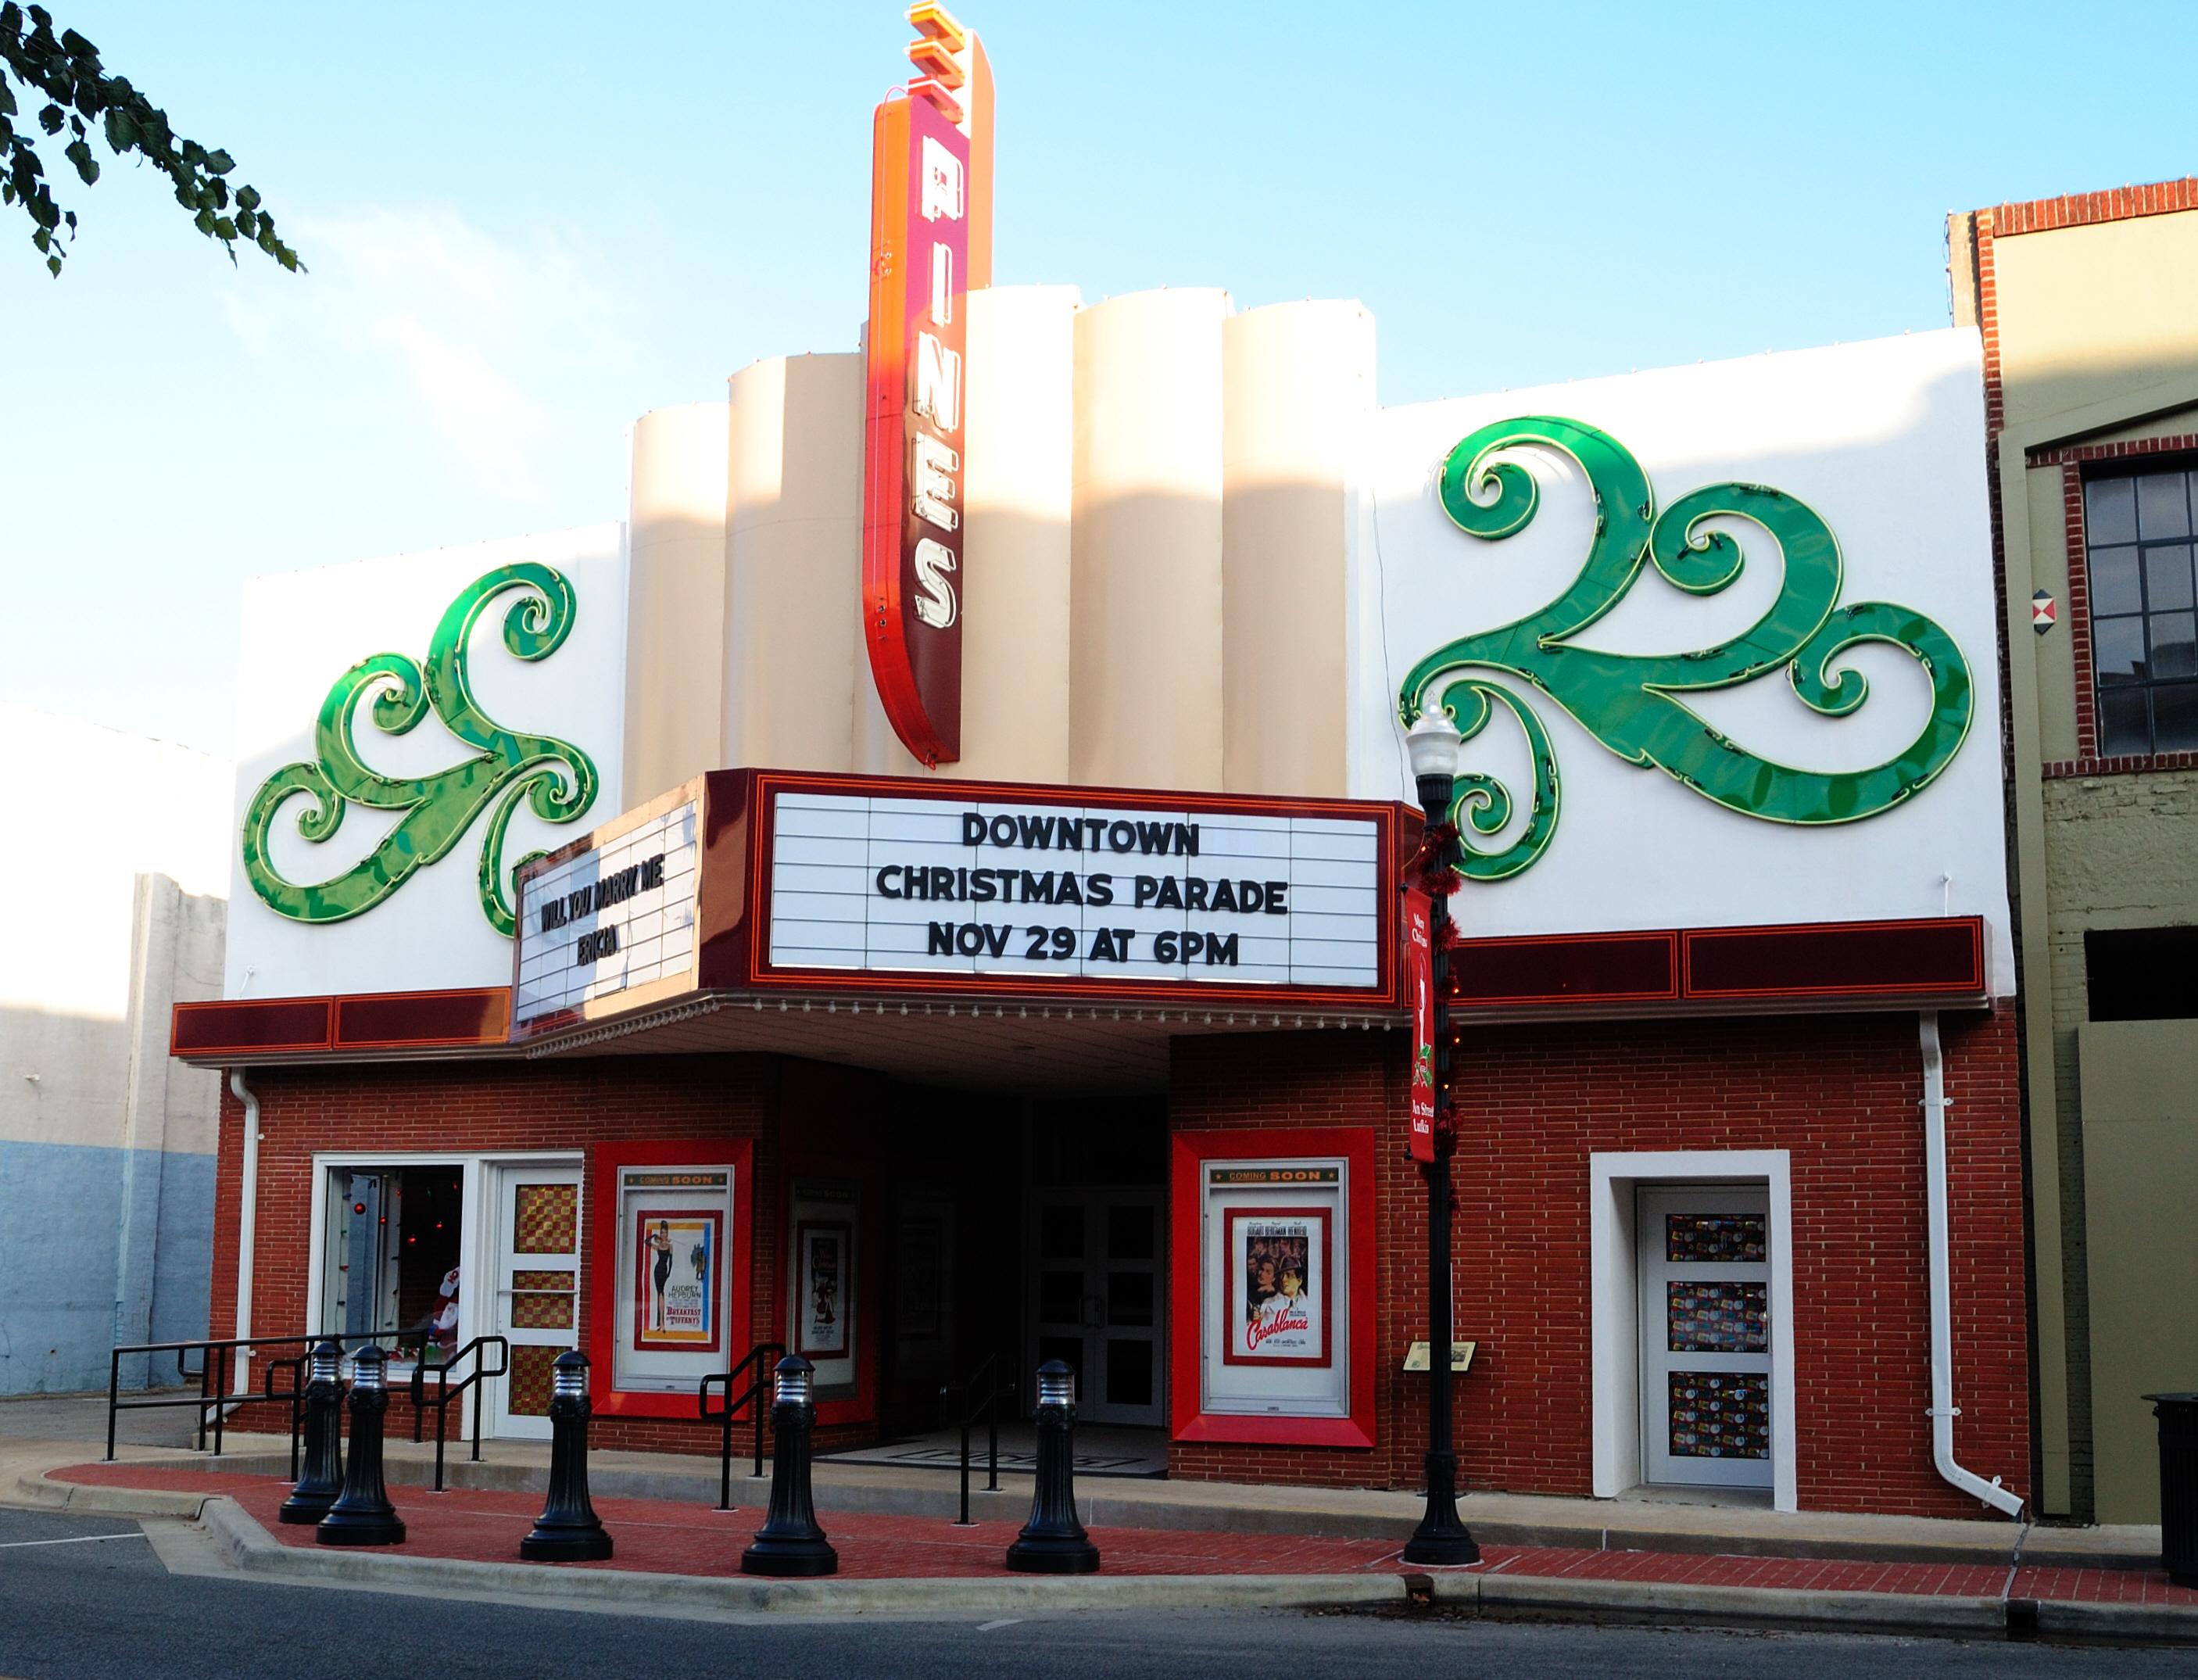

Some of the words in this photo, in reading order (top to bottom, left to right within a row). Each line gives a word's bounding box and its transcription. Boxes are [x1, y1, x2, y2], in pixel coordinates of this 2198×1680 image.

[962, 811, 1200, 857] DOWNTOWN
[541, 897, 567, 933] WILL
[568, 884, 592, 922] YOU
[594, 864, 639, 912] MARRY
[641, 853, 665, 892] ME
[876, 865, 1114, 907] CHRISTMAS
[1134, 875, 1288, 915] PARADE
[928, 921, 1013, 958] NOV
[1025, 925, 1076, 960] 29
[1089, 927, 1136, 962] AT
[1154, 930, 1239, 966] 6PM
[671, 1175, 713, 1184] SOON
[1229, 1171, 1266, 1180] COMING
[1269, 1170, 1320, 1180] SOON
[1246, 1308, 1308, 1350] Casablanca
